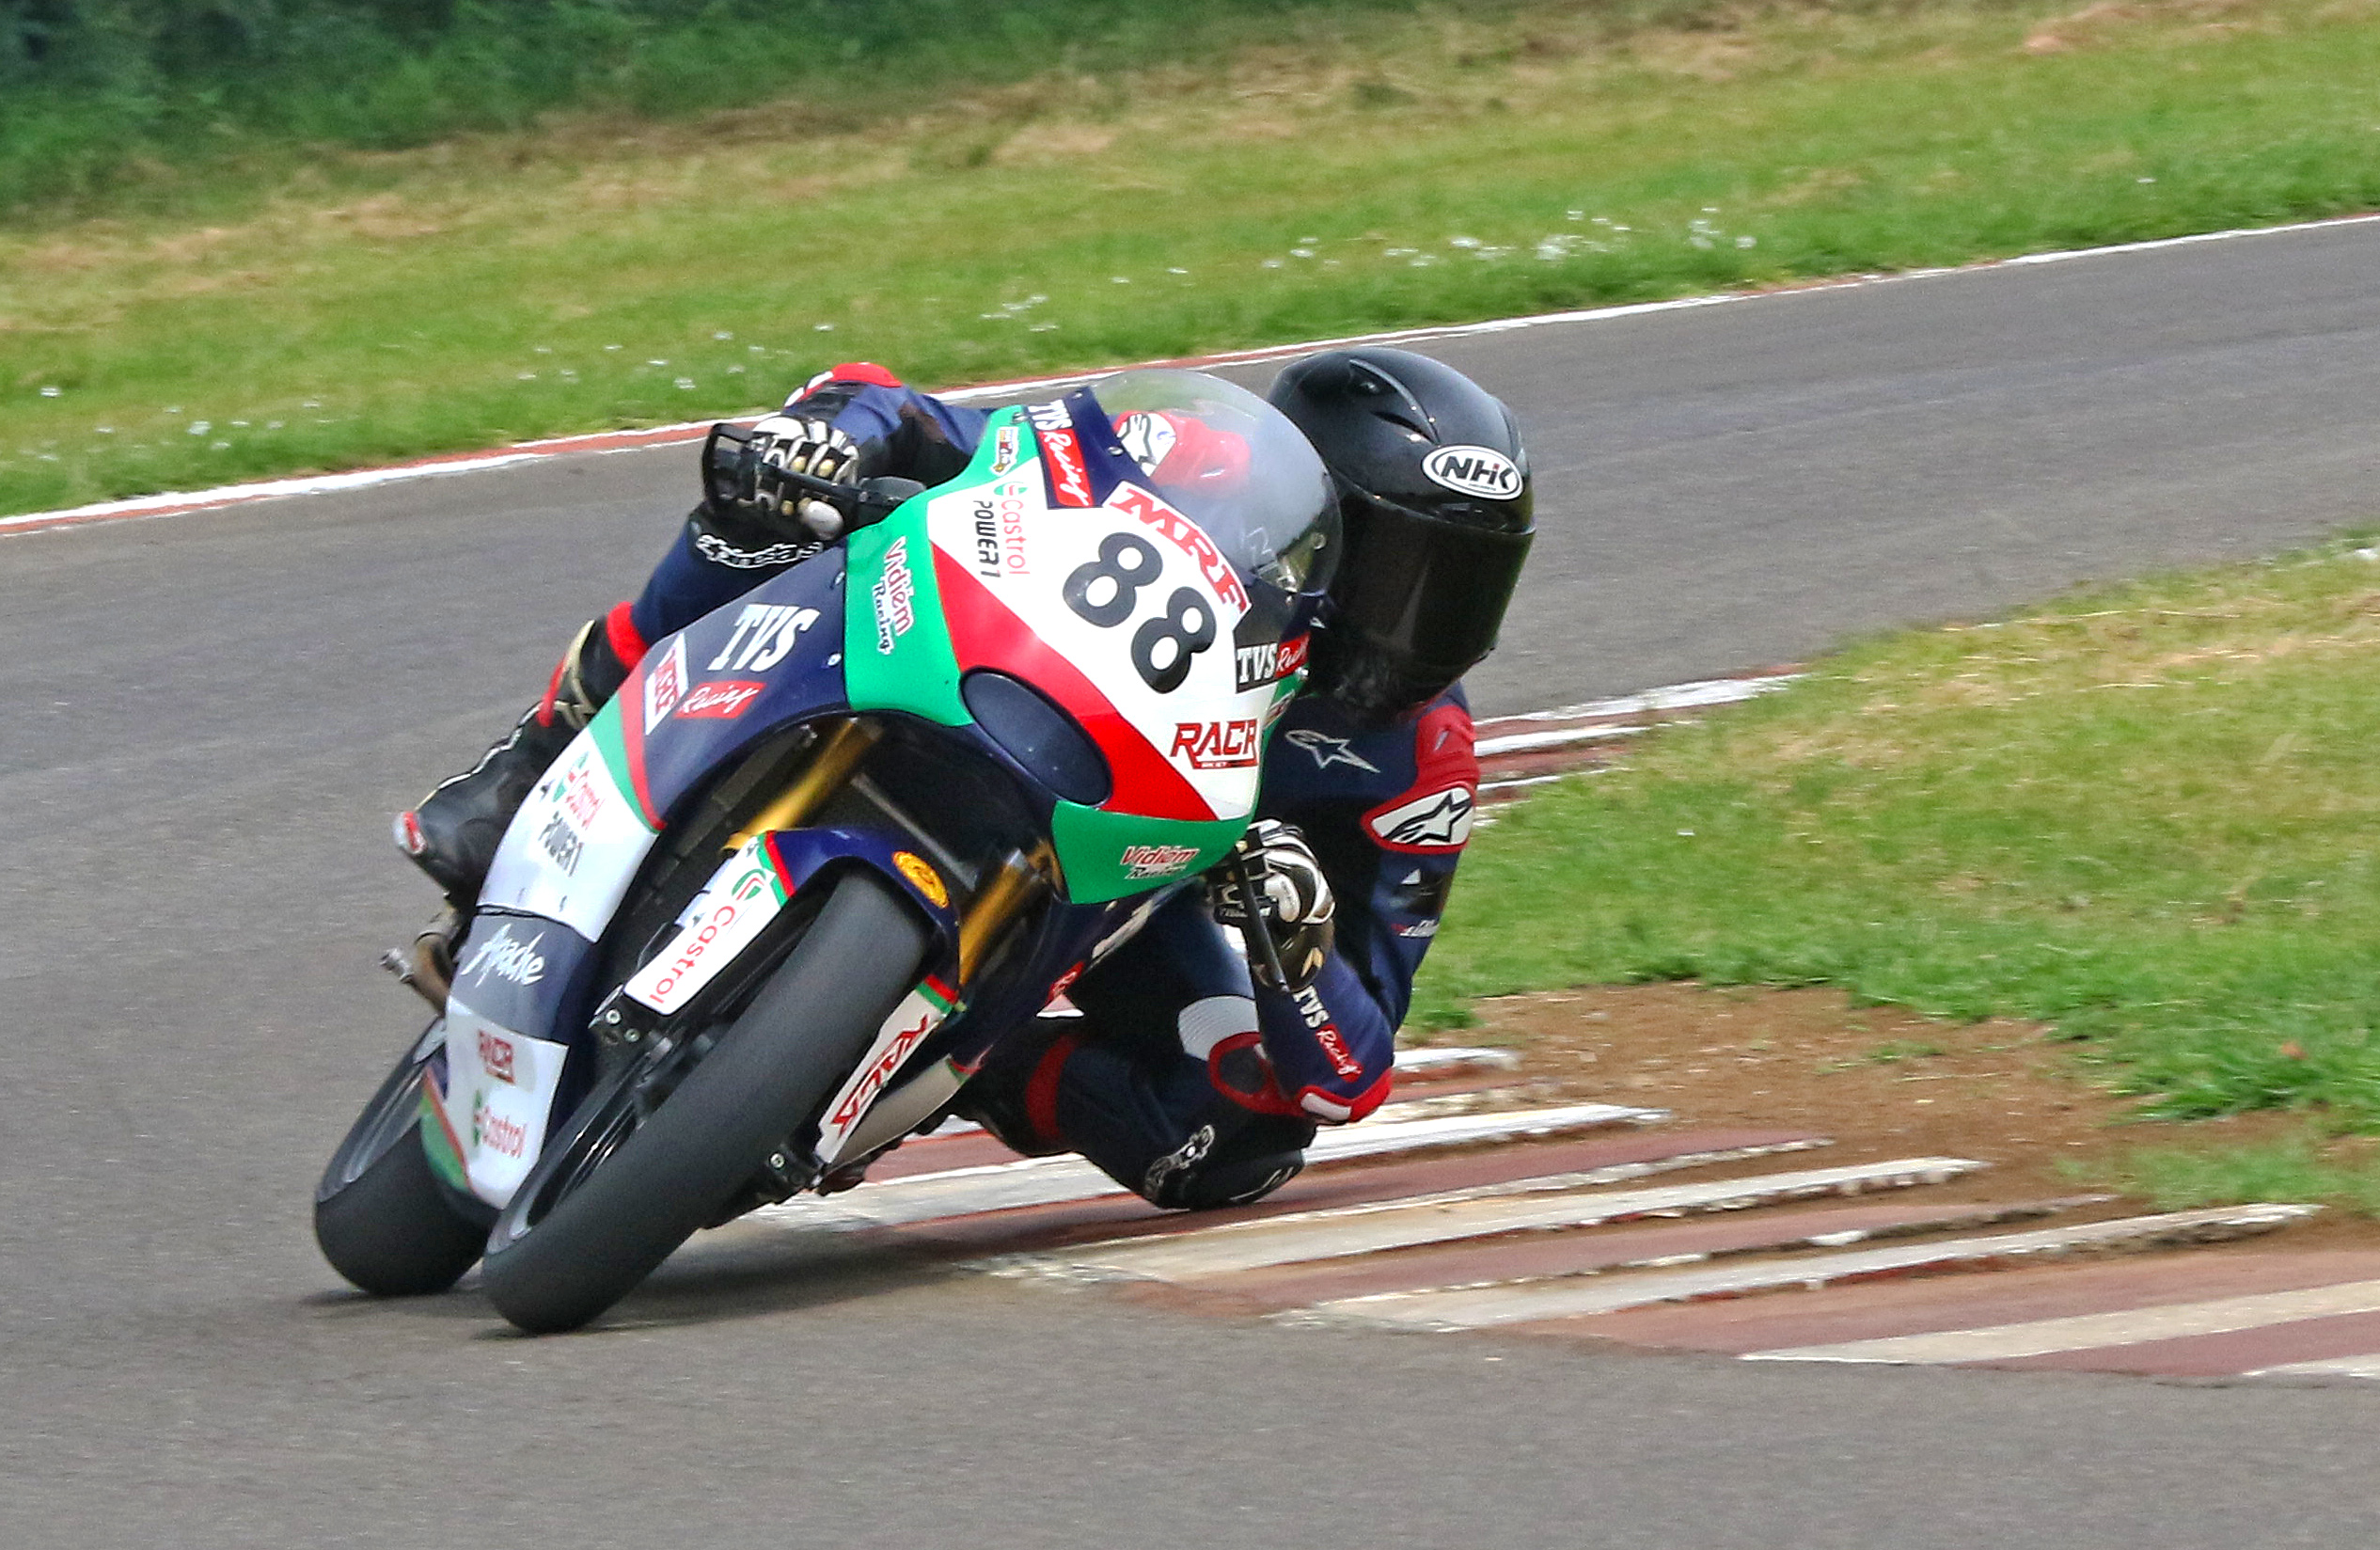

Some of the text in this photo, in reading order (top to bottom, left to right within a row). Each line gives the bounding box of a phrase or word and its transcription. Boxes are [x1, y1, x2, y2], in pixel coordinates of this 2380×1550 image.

[1027, 399, 1090, 506] TVS Racing
[1440, 455, 1514, 490] NHK
[1109, 488, 1247, 613] MRF
[707, 604, 821, 672] TVS
[1063, 531, 1217, 694] 88
[1237, 642, 1279, 684] TVS
[681, 684, 760, 714] Racing
[1170, 719, 1258, 769] RACR
[461, 923, 544, 989] Apache
[1292, 985, 1331, 1029] TVS
